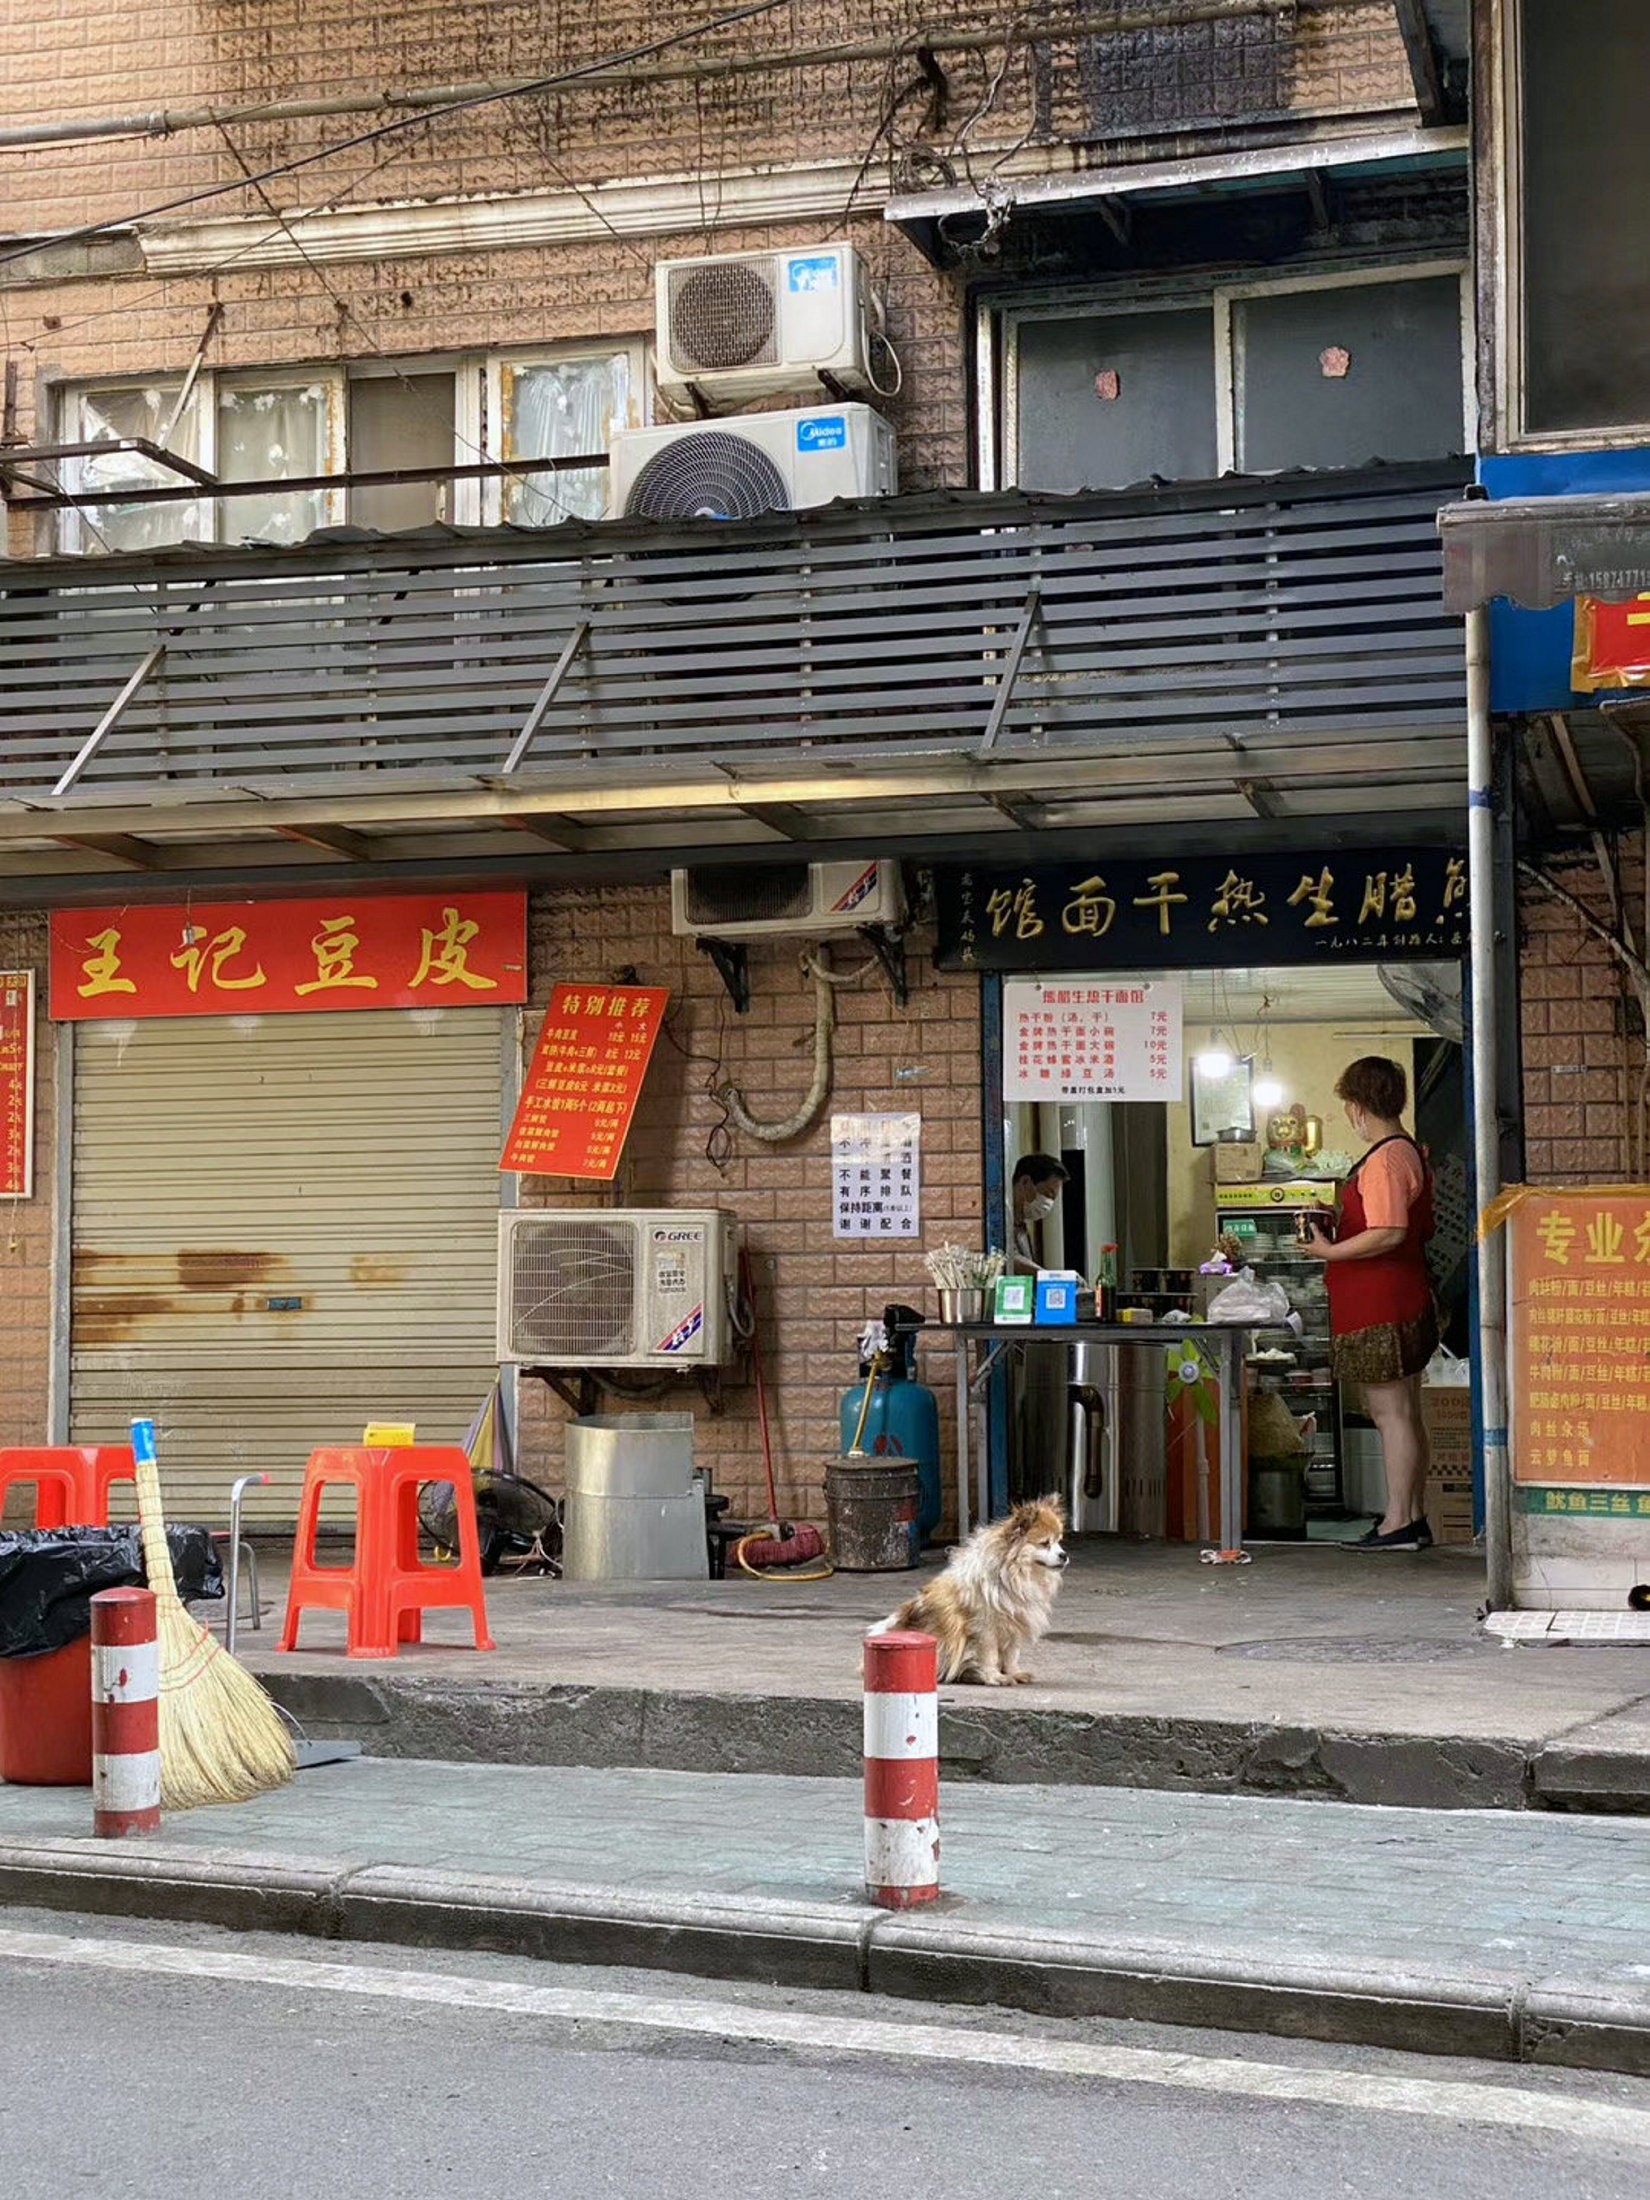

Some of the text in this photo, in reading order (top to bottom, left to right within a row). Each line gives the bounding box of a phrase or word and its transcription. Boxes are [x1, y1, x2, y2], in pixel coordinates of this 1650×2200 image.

[809, 427, 842, 437] Midea
[77, 907, 499, 999] 王记豆皮
[562, 994, 651, 1017] 特别推荐
[1019, 1026, 1114, 1036] 金牌热干面小碗
[1019, 1040, 1168, 1051] 金牌热干面大碗 10元
[1019, 1068, 1114, 1079] 冰糖绿豆汤
[839, 1168, 912, 1181] 不能聚餐
[840, 1185, 912, 1197] 有序排队
[840, 1218, 912, 1230] 谢谢配合
[668, 1231, 702, 1241] GREE
[1530, 1449, 1590, 1467] 云梦鱼面
[1546, 1490, 1631, 1512] 鱿鱼三丝
